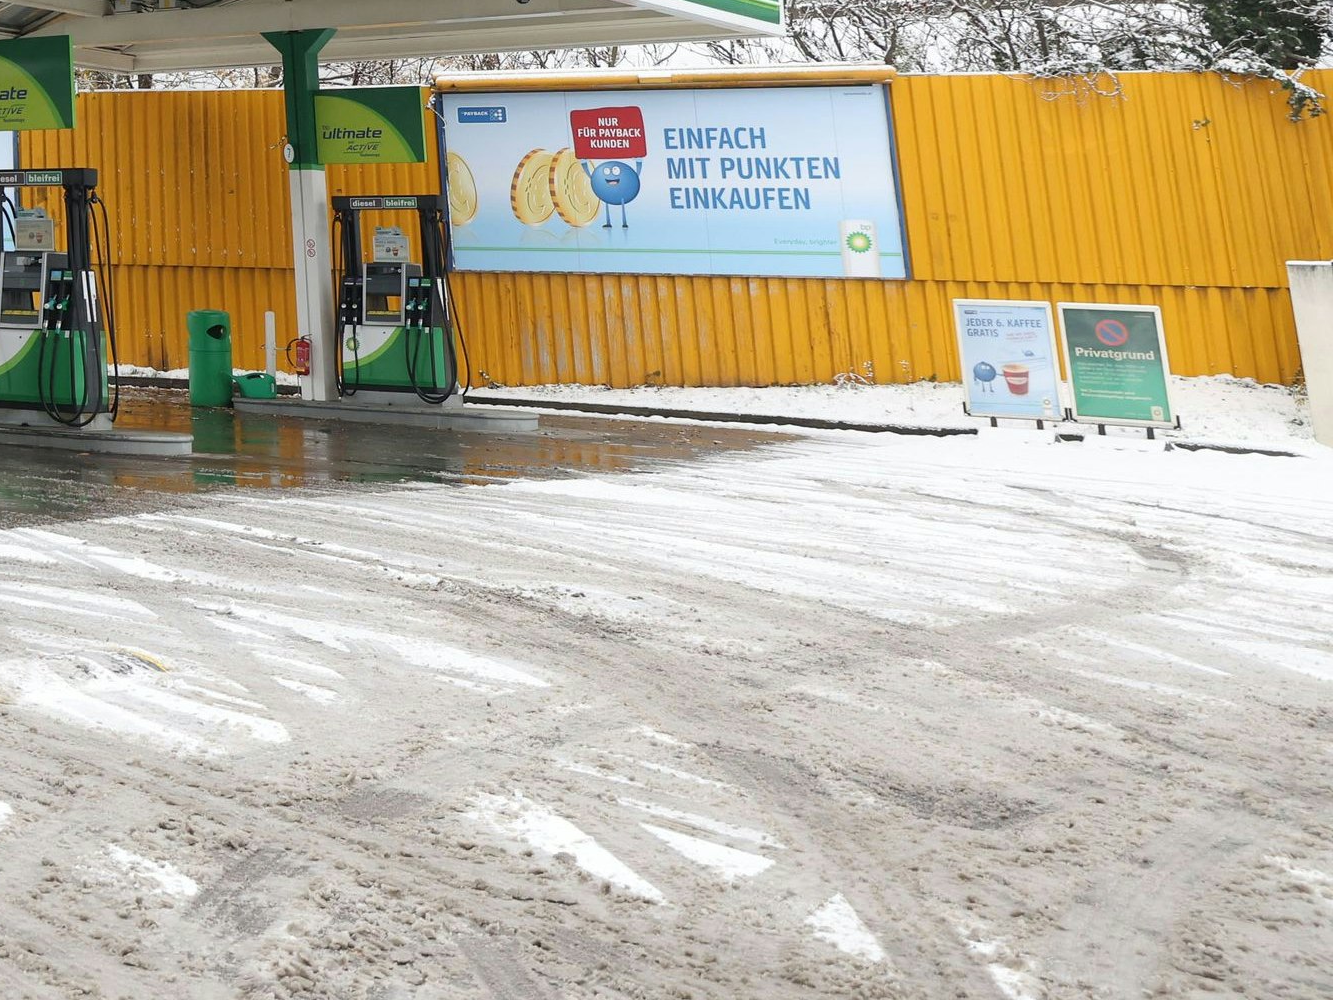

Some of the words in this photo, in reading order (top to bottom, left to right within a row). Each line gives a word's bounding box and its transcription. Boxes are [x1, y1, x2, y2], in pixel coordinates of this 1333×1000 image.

[597, 117, 619, 127] NUR
[323, 127, 383, 139] ultimate
[578, 126, 597, 138] FÜR
[598, 128, 642, 138] PAYBACK
[663, 126, 767, 150] EINFACH
[346, 143, 380, 151] ACTIVE
[590, 139, 631, 149] KUNDEN
[666, 157, 711, 180] MIT
[719, 156, 841, 180] PUNKTEN
[28, 173, 60, 183] bleifrei
[385, 198, 415, 207] bleifrei
[669, 187, 812, 211] EINKAUFEN
[966, 317, 994, 327] JEDER
[996, 318, 1005, 327] 6.
[1007, 319, 1042, 328] KAFFEE
[967, 328, 999, 337] GRATIS
[1074, 346, 1155, 361] Privatgrund
